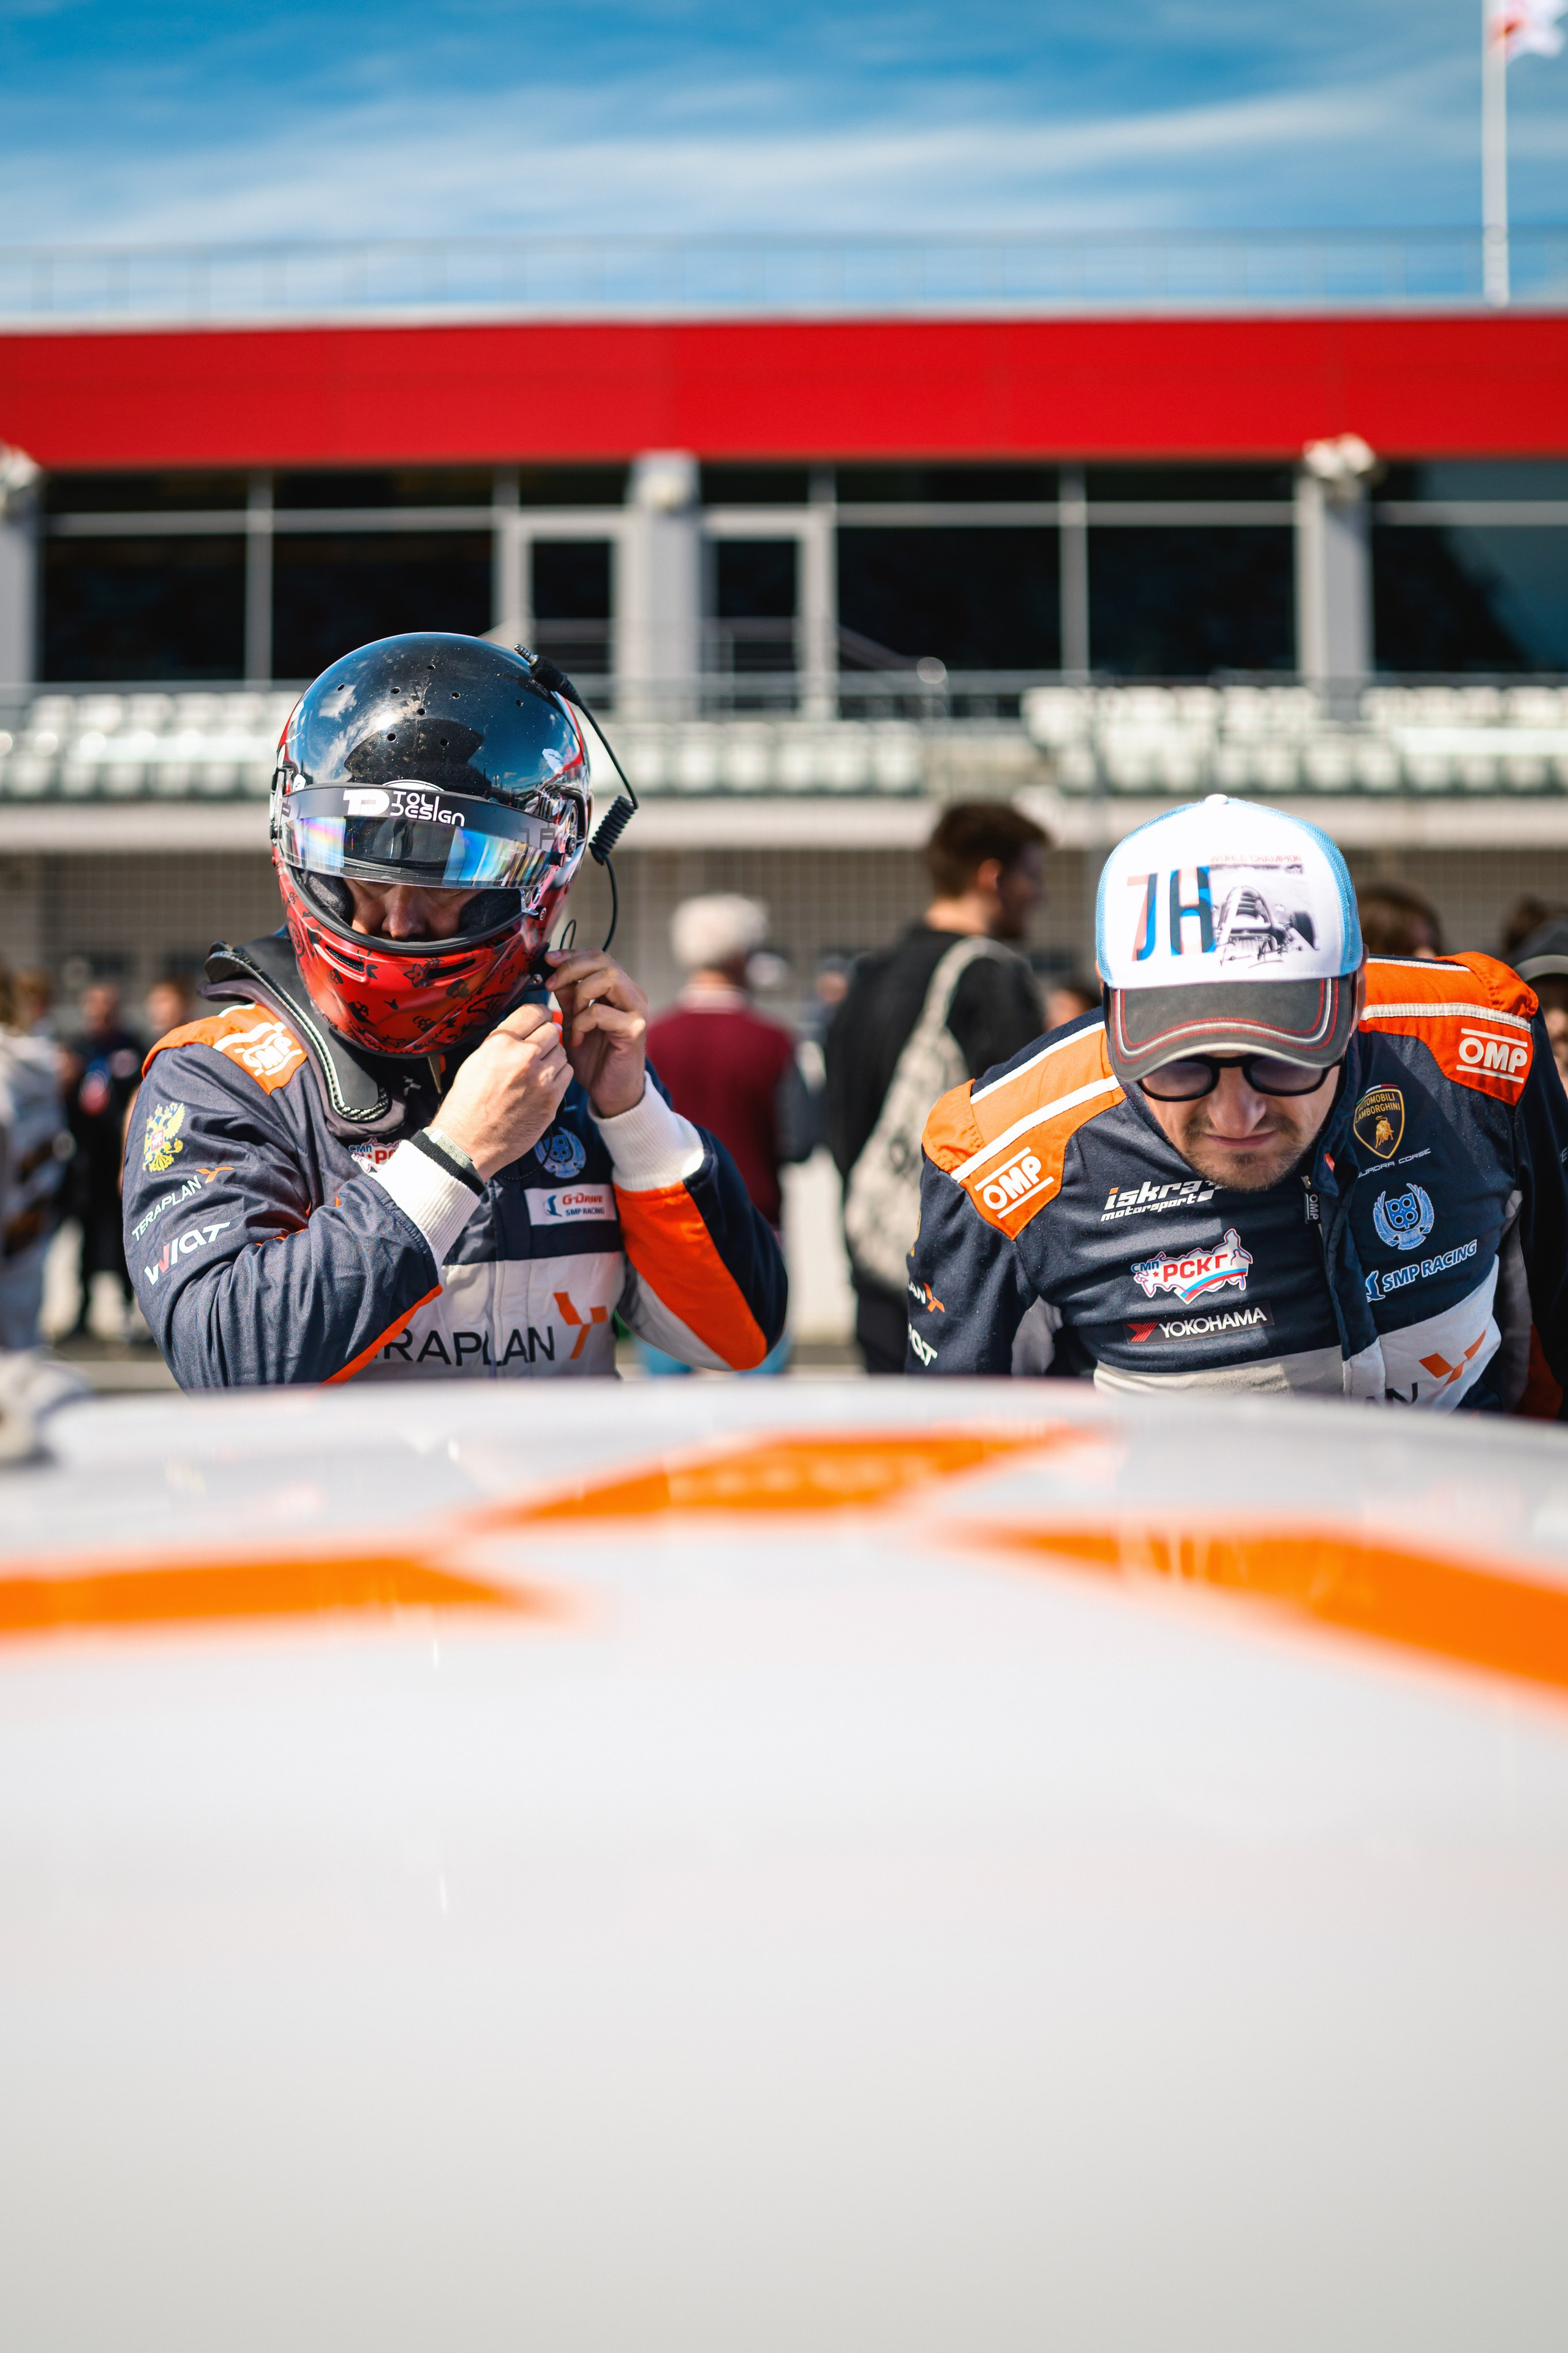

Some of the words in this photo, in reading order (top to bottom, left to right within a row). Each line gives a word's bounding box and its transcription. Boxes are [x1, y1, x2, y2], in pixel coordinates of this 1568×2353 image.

[1458, 1037, 1528, 1073] OMP
[1355, 1102, 1401, 1124] LAMBORGHINI
[1398, 1148, 1431, 1164] CORSE
[982, 1155, 1042, 1210] OMP
[1104, 1180, 1203, 1210] iskra
[131, 1175, 202, 1242] TERAPLAN
[565, 1208, 582, 1217] SMP
[1100, 1193, 1197, 1222] motorsport
[1310, 1195, 1319, 1220] OMP
[1131, 1261, 1159, 1272] СМП
[1163, 1253, 1228, 1283] РСКГ
[1382, 1264, 1420, 1293] SMP
[1421, 1239, 1478, 1278] RACING
[1158, 1307, 1268, 1339] YOKOHAMA
[374, 1325, 556, 1367] RAPLAN
